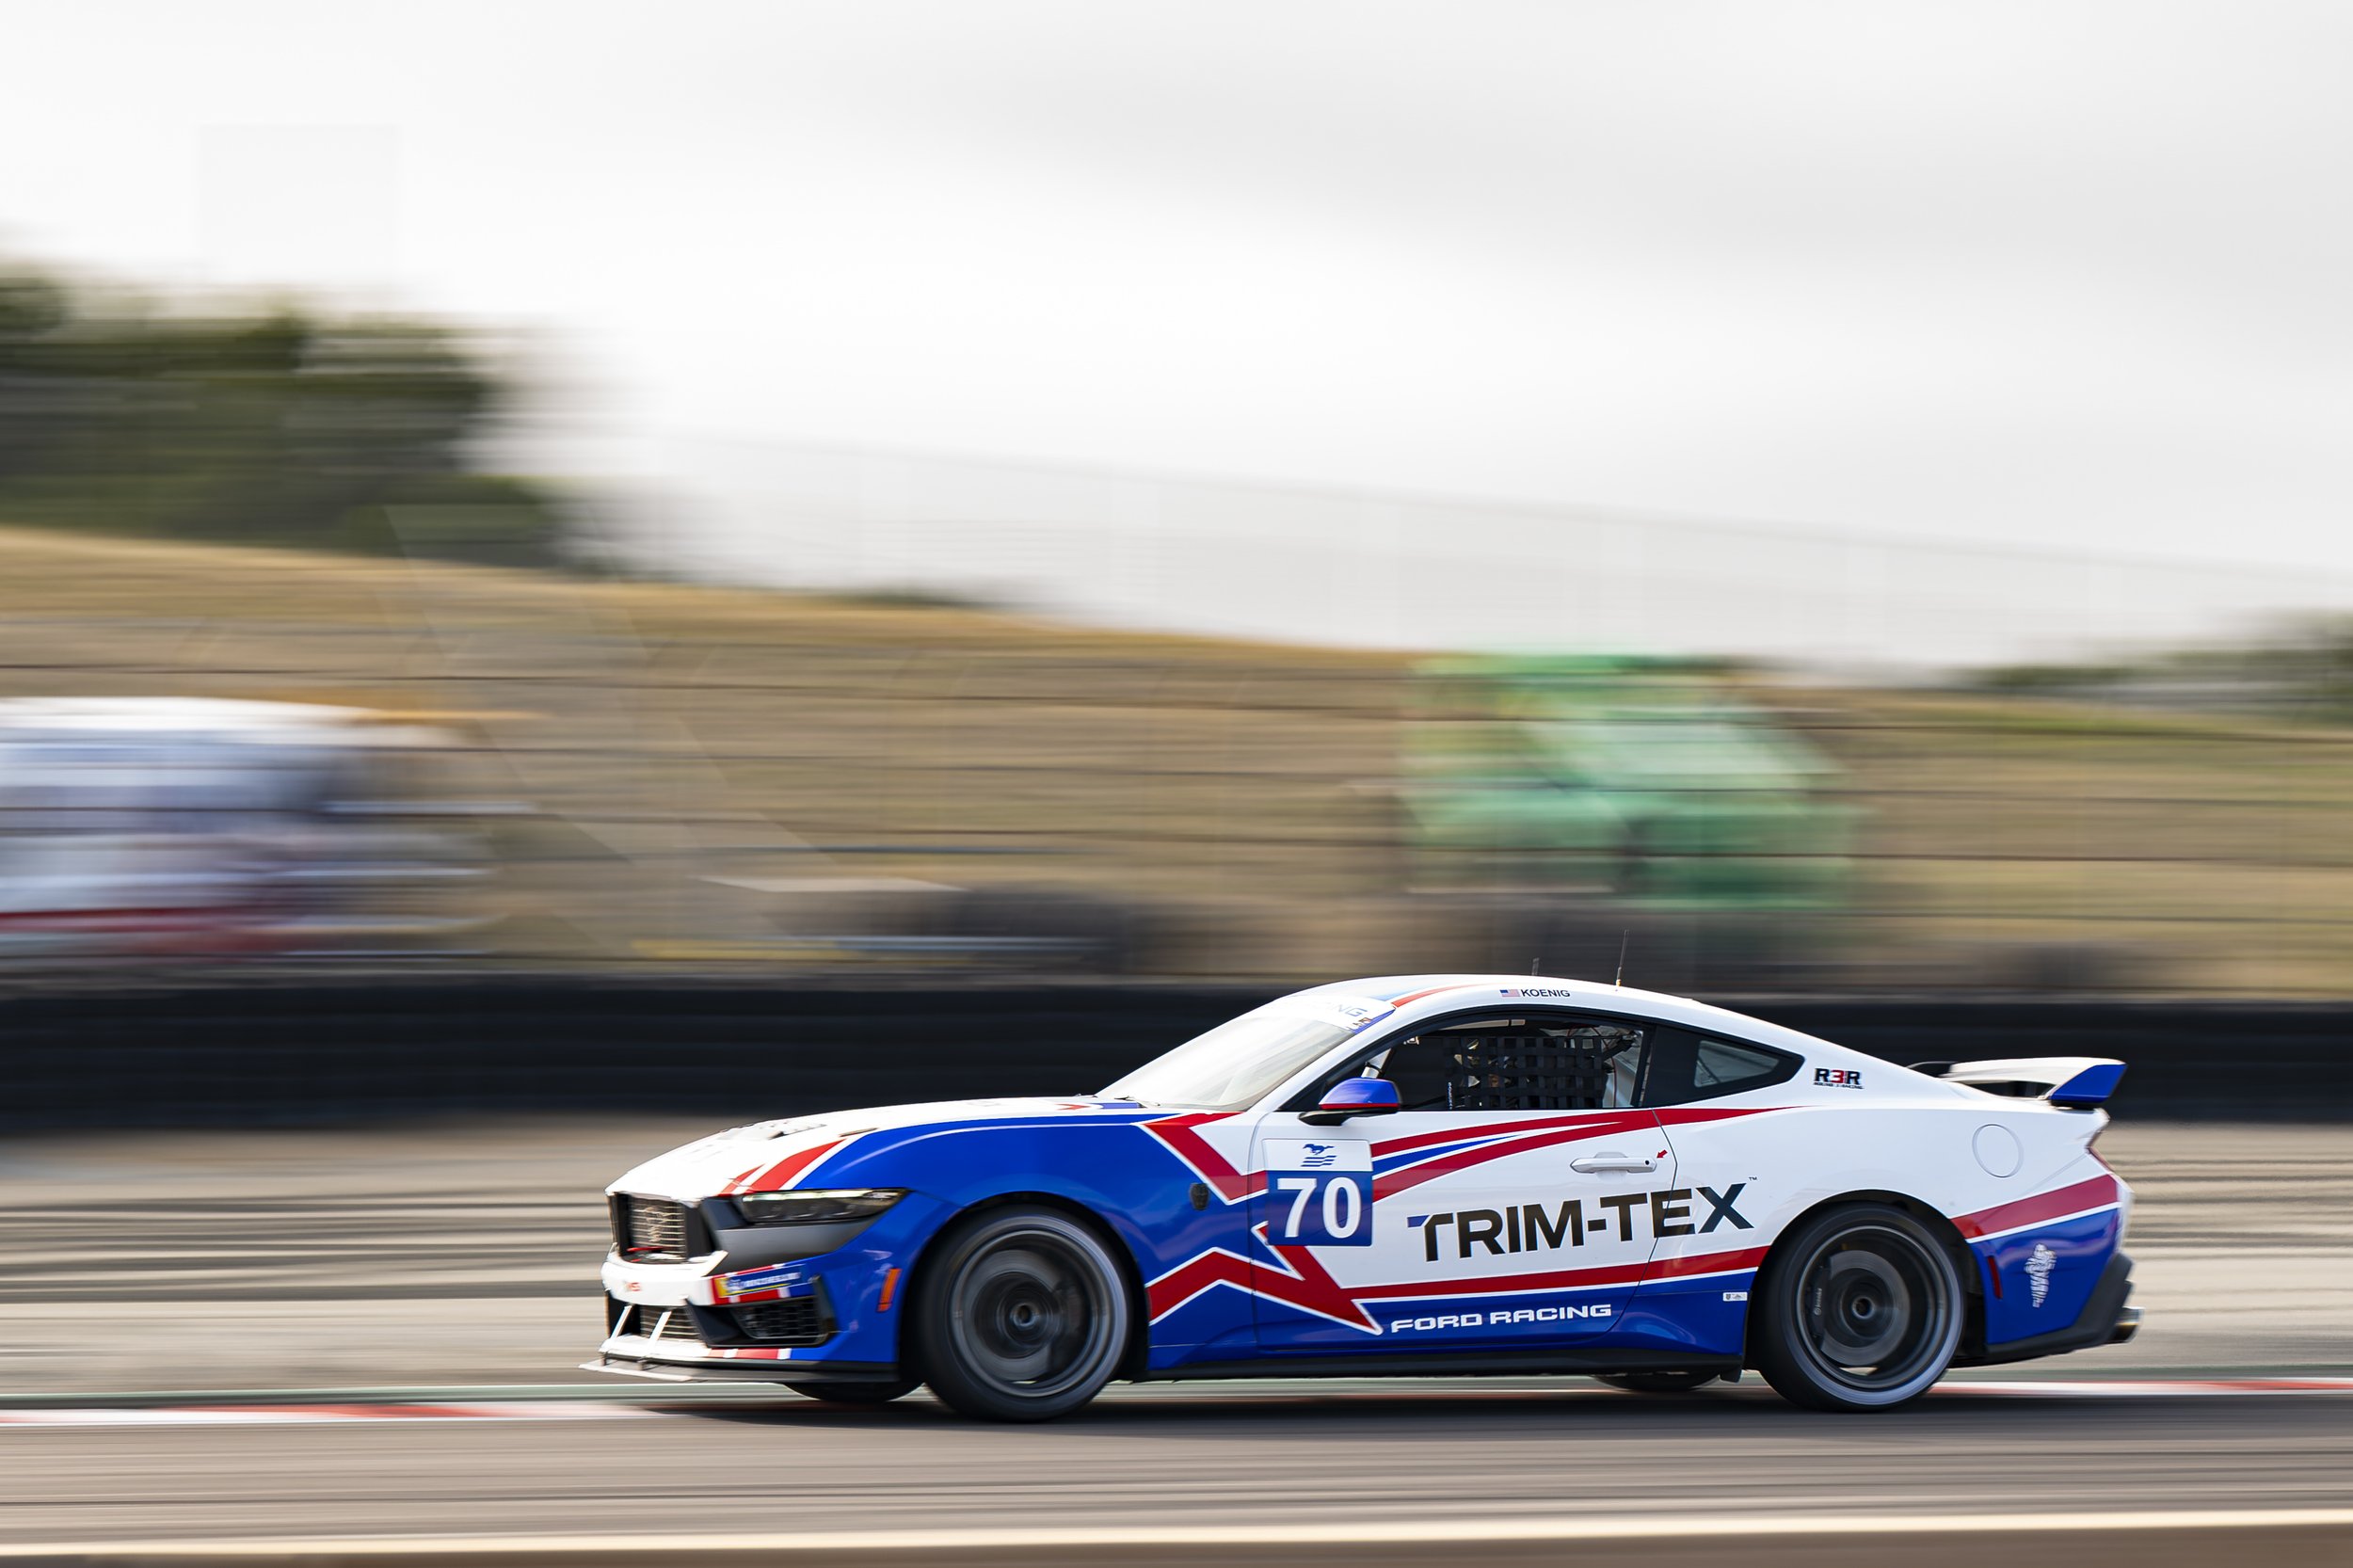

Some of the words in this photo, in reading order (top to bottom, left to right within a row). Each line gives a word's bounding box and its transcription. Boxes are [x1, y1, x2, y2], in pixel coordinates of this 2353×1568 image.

[1520, 988, 1571, 998] KOENIG
[1814, 1067, 1861, 1085] R3R
[1276, 1176, 1362, 1240] 70
[1406, 1182, 1755, 1263] TRIM-TEX
[1390, 1313, 1483, 1334] FORD
[1489, 1304, 1612, 1325] RACING
